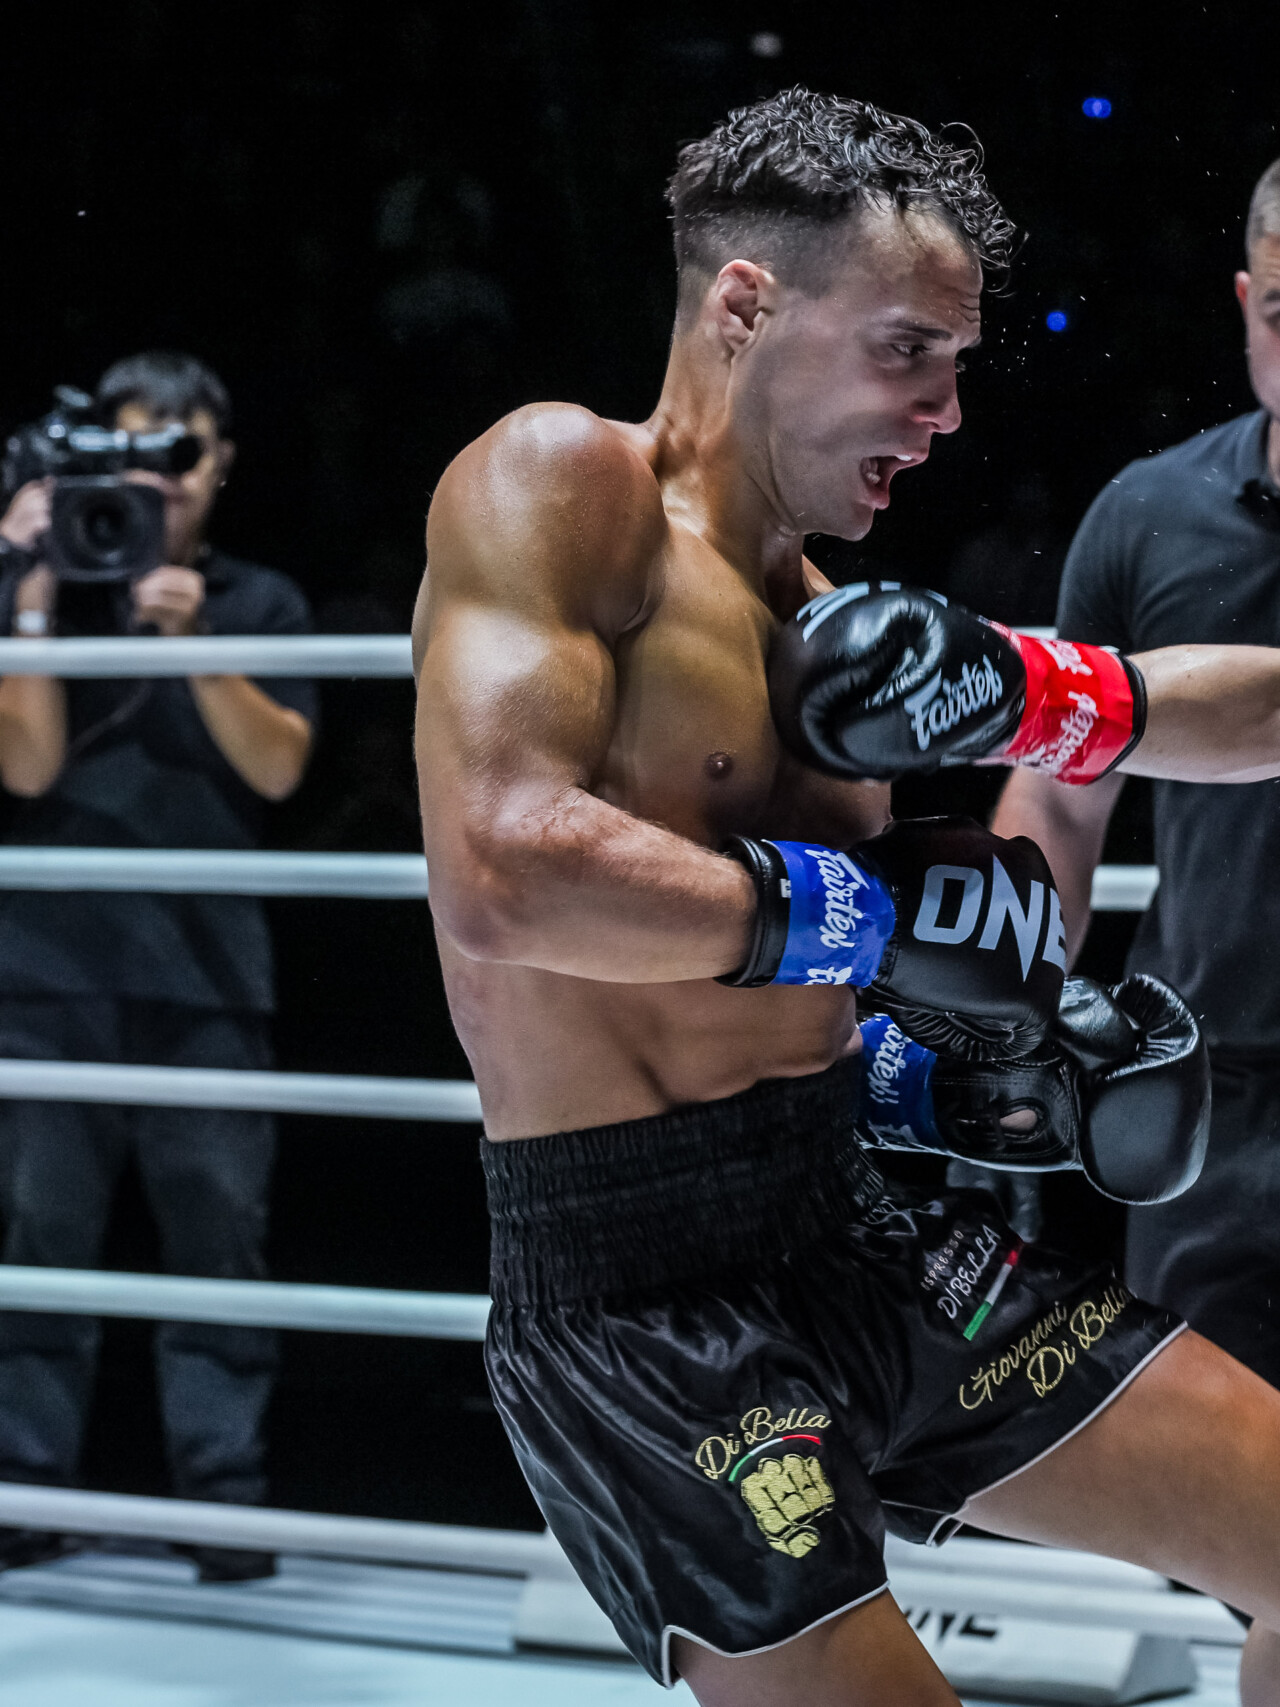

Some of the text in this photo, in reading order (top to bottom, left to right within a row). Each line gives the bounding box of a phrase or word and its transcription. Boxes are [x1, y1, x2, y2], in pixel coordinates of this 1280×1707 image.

[903, 653, 1003, 751] Fairtex
[804, 848, 870, 949] Fairtex
[959, 1300, 1068, 1410] Giovanni
[1026, 1340, 1076, 1399] Di
[694, 1406, 833, 1480] Di Bella
